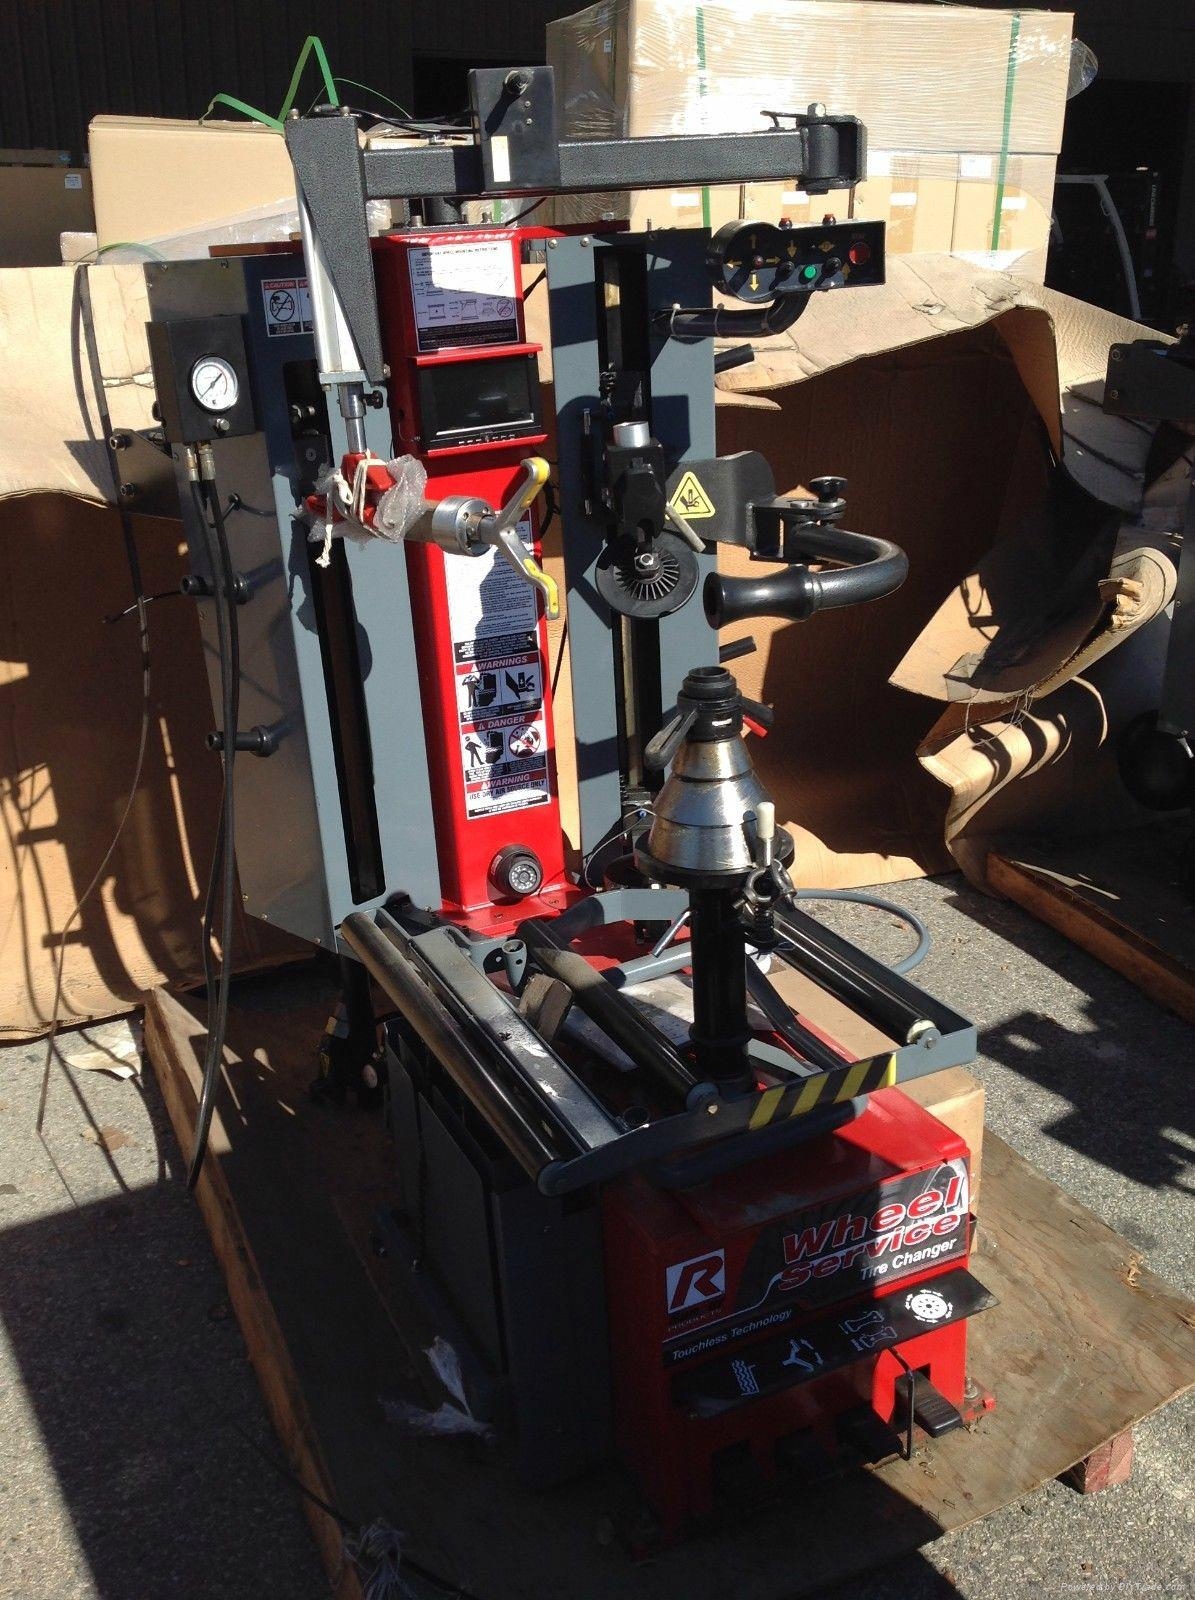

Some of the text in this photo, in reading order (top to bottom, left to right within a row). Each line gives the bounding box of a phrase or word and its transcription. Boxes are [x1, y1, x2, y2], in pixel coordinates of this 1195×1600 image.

[477, 655, 528, 670] WARNINGS
[487, 716, 525, 727] DANGER
[486, 773, 530, 788] WARNING
[495, 787, 506, 795] AIR
[507, 782, 529, 792] SOURCE
[530, 779, 544, 788] ONLY
[859, 1237, 958, 1280] Tire Changer
[672, 1334, 728, 1361] Touchless
[730, 1308, 793, 1338] Technology
